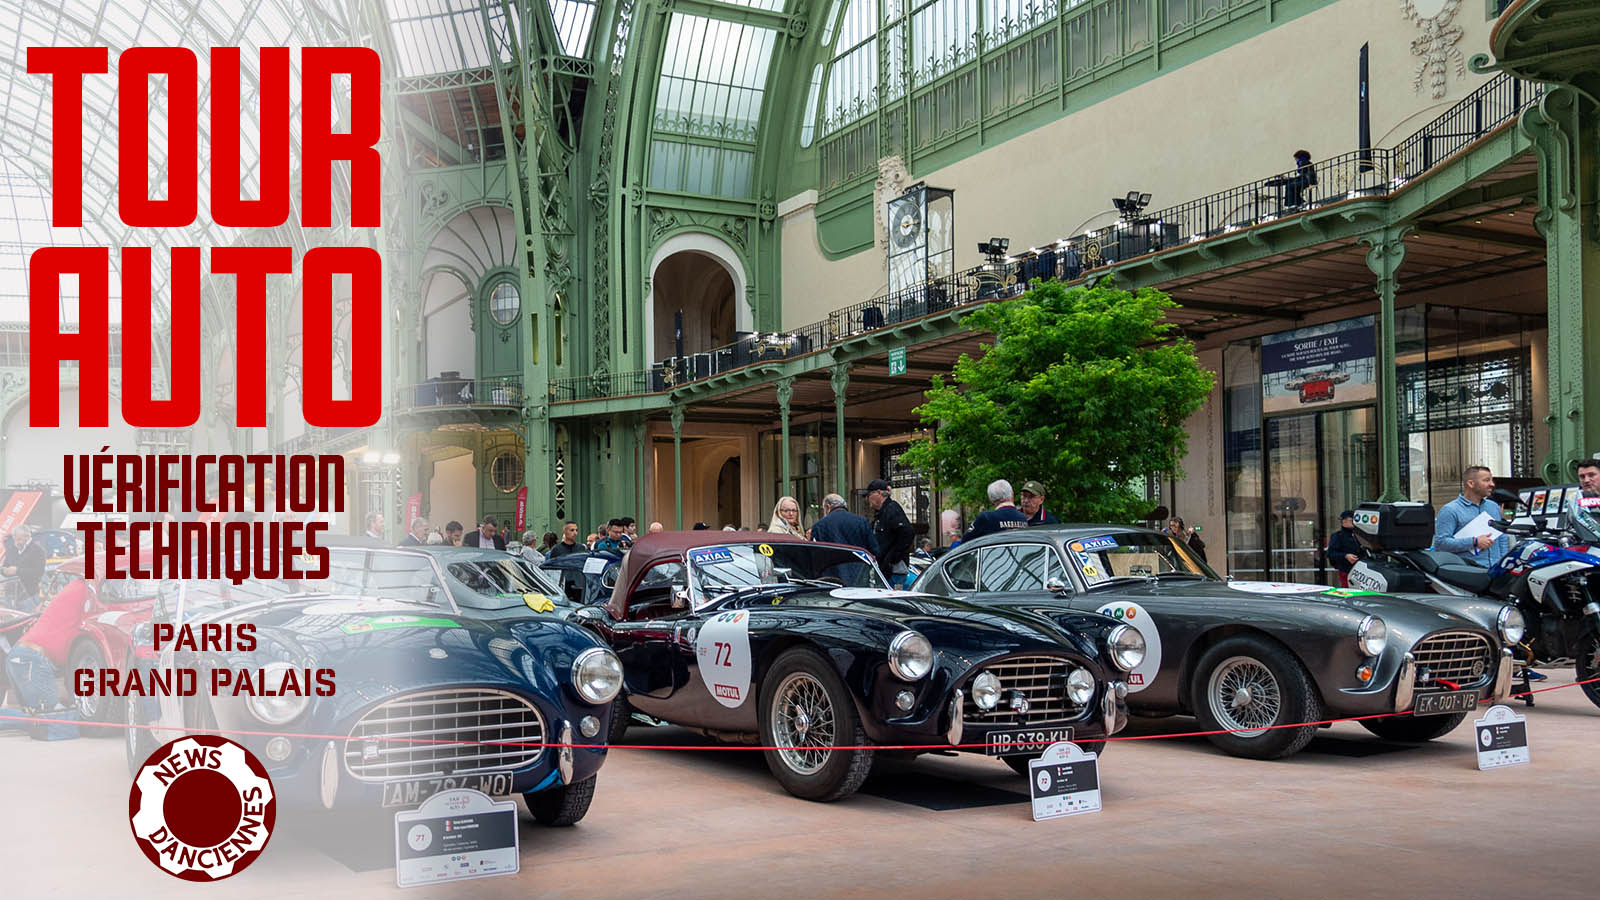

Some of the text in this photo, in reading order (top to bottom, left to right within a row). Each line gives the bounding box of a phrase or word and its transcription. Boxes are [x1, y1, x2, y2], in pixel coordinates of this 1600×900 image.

[1294, 340, 1318, 352] SORTIE
[1324, 336, 1339, 346] EXIT
[1084, 540, 1115, 549] AXIAL
[695, 551, 731, 563] AXIAL
[1351, 569, 1383, 591] PRODUCTION
[714, 642, 732, 667] 72
[716, 685, 739, 699] MOTUL
